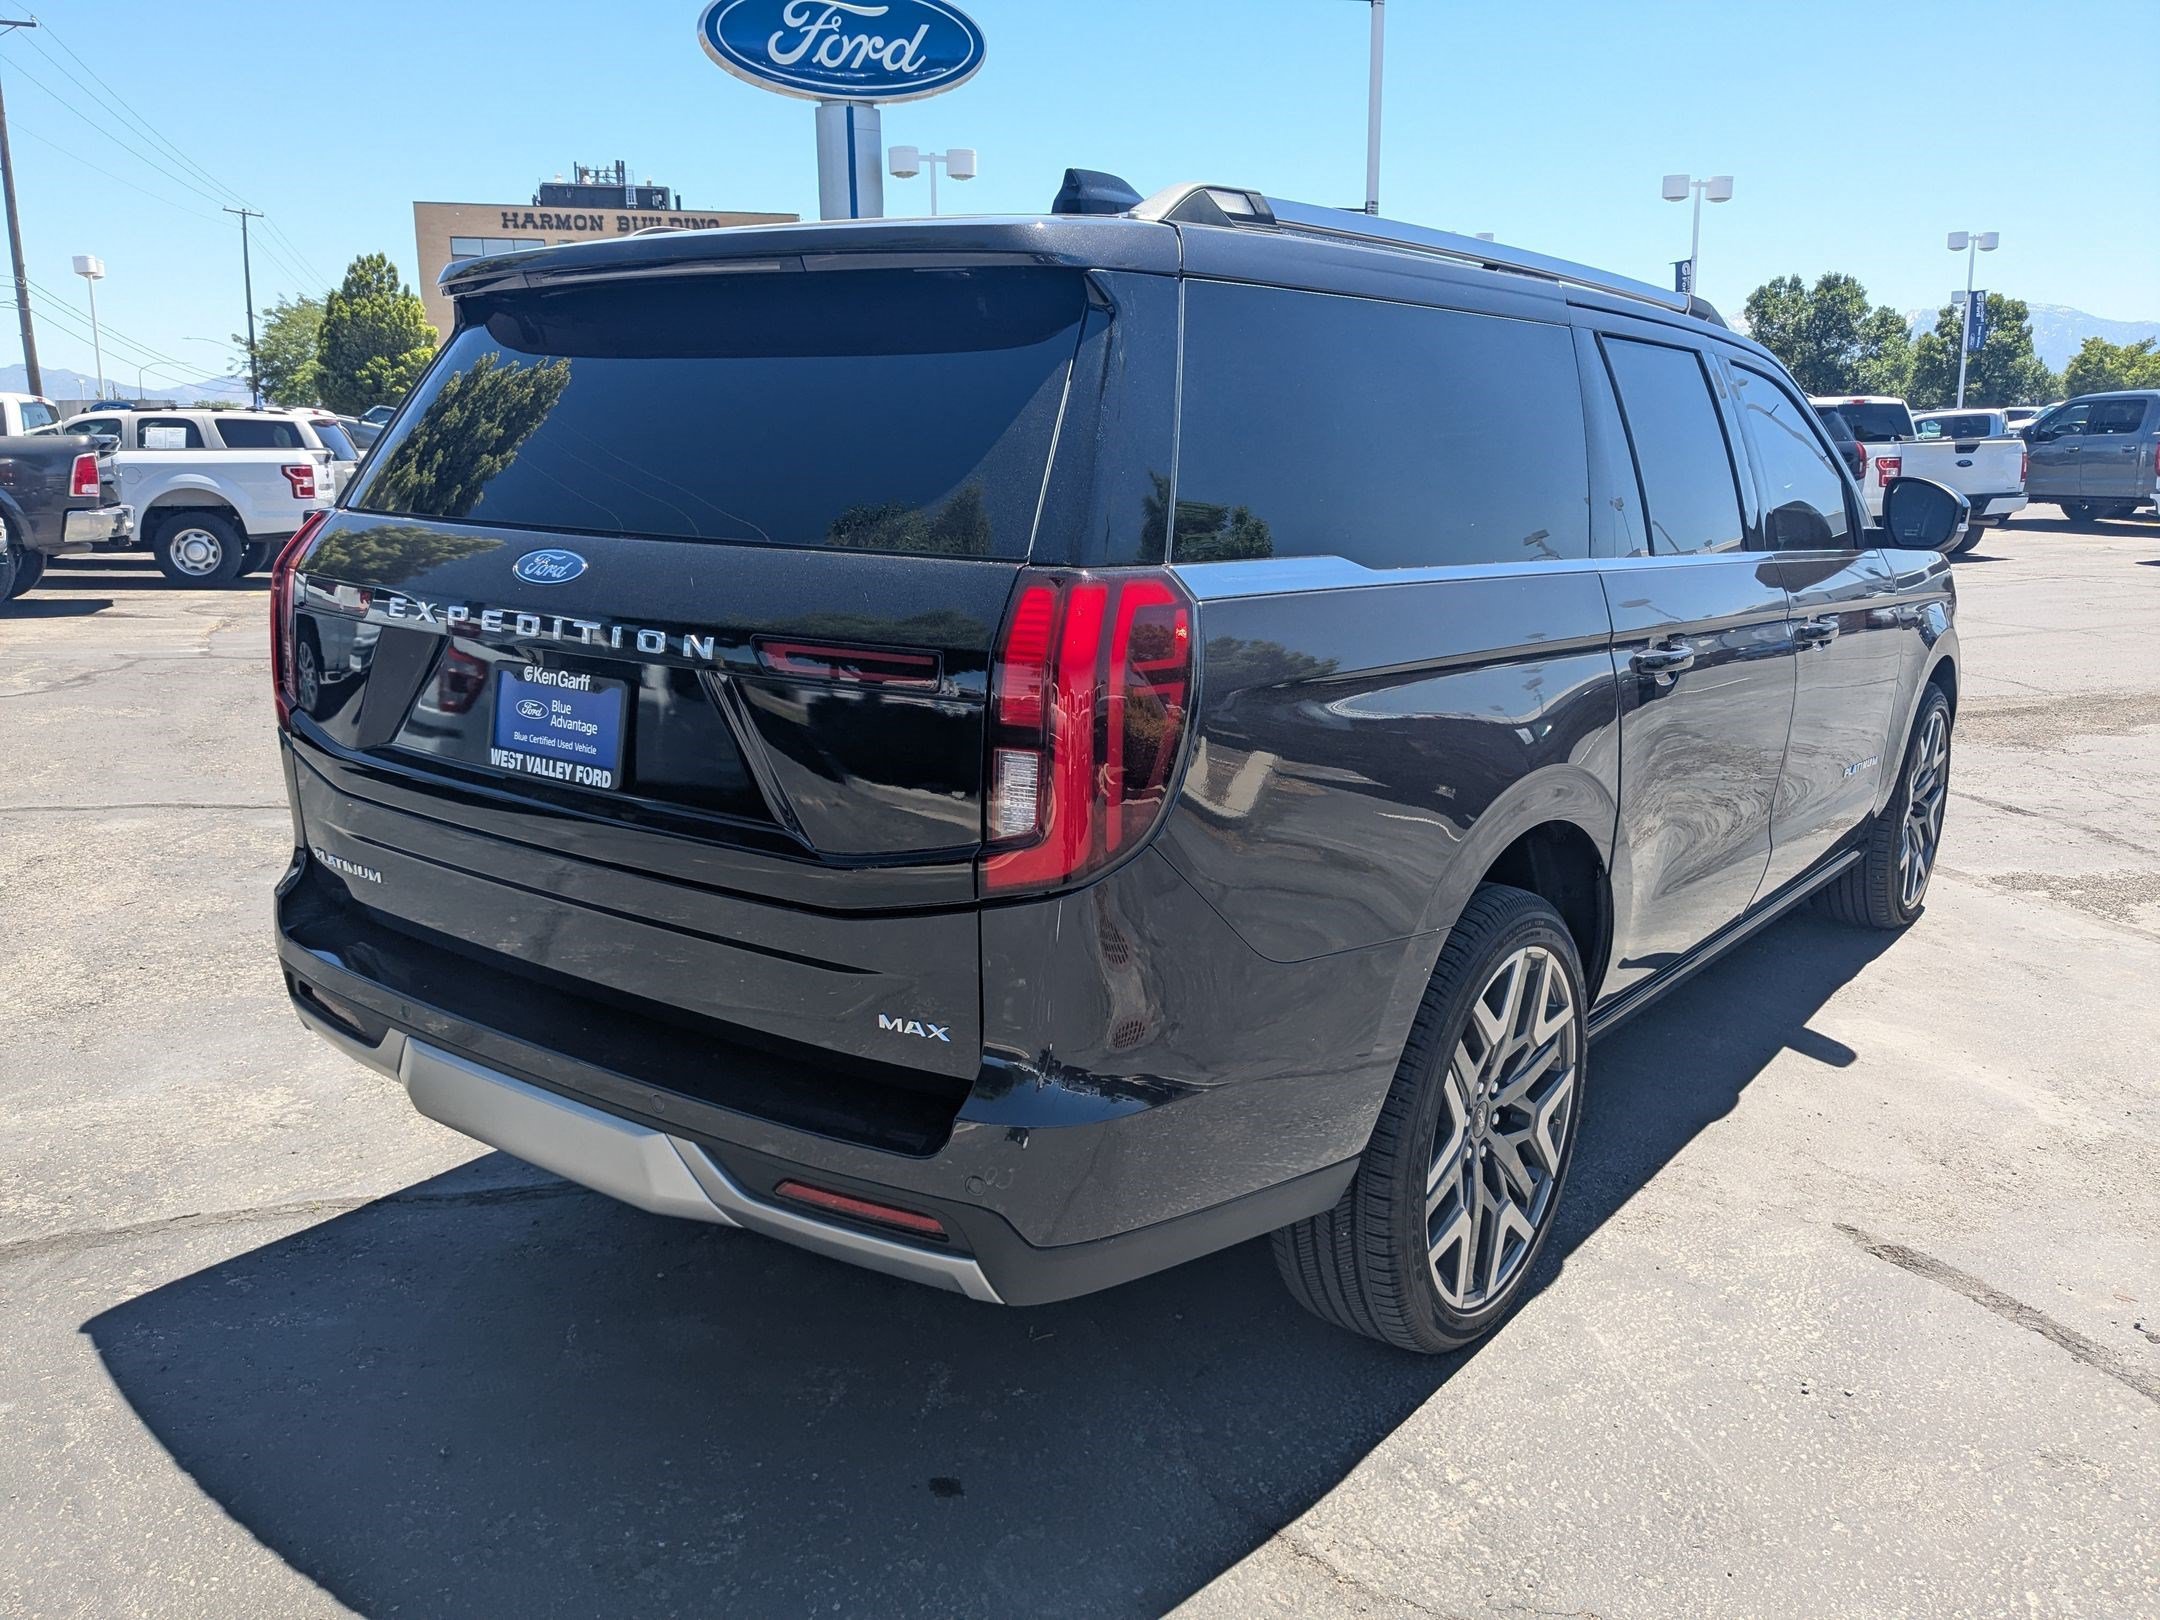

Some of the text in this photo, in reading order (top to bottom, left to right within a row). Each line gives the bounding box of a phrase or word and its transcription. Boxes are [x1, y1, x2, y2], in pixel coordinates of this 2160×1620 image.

[767, 0, 930, 73] Ford
[501, 211, 604, 232] HARMON
[525, 553, 574, 579] Ford
[388, 596, 715, 660] EXPEDITION
[521, 701, 543, 717] Ford
[551, 700, 572, 715] Blue
[550, 715, 598, 736] Advantage
[513, 731, 598, 755] Blue Certified Used Vehicle
[490, 748, 612, 789] WEST VALLEY FORD
[313, 847, 382, 884] PLATINUM
[878, 1013, 951, 1042] MAX
